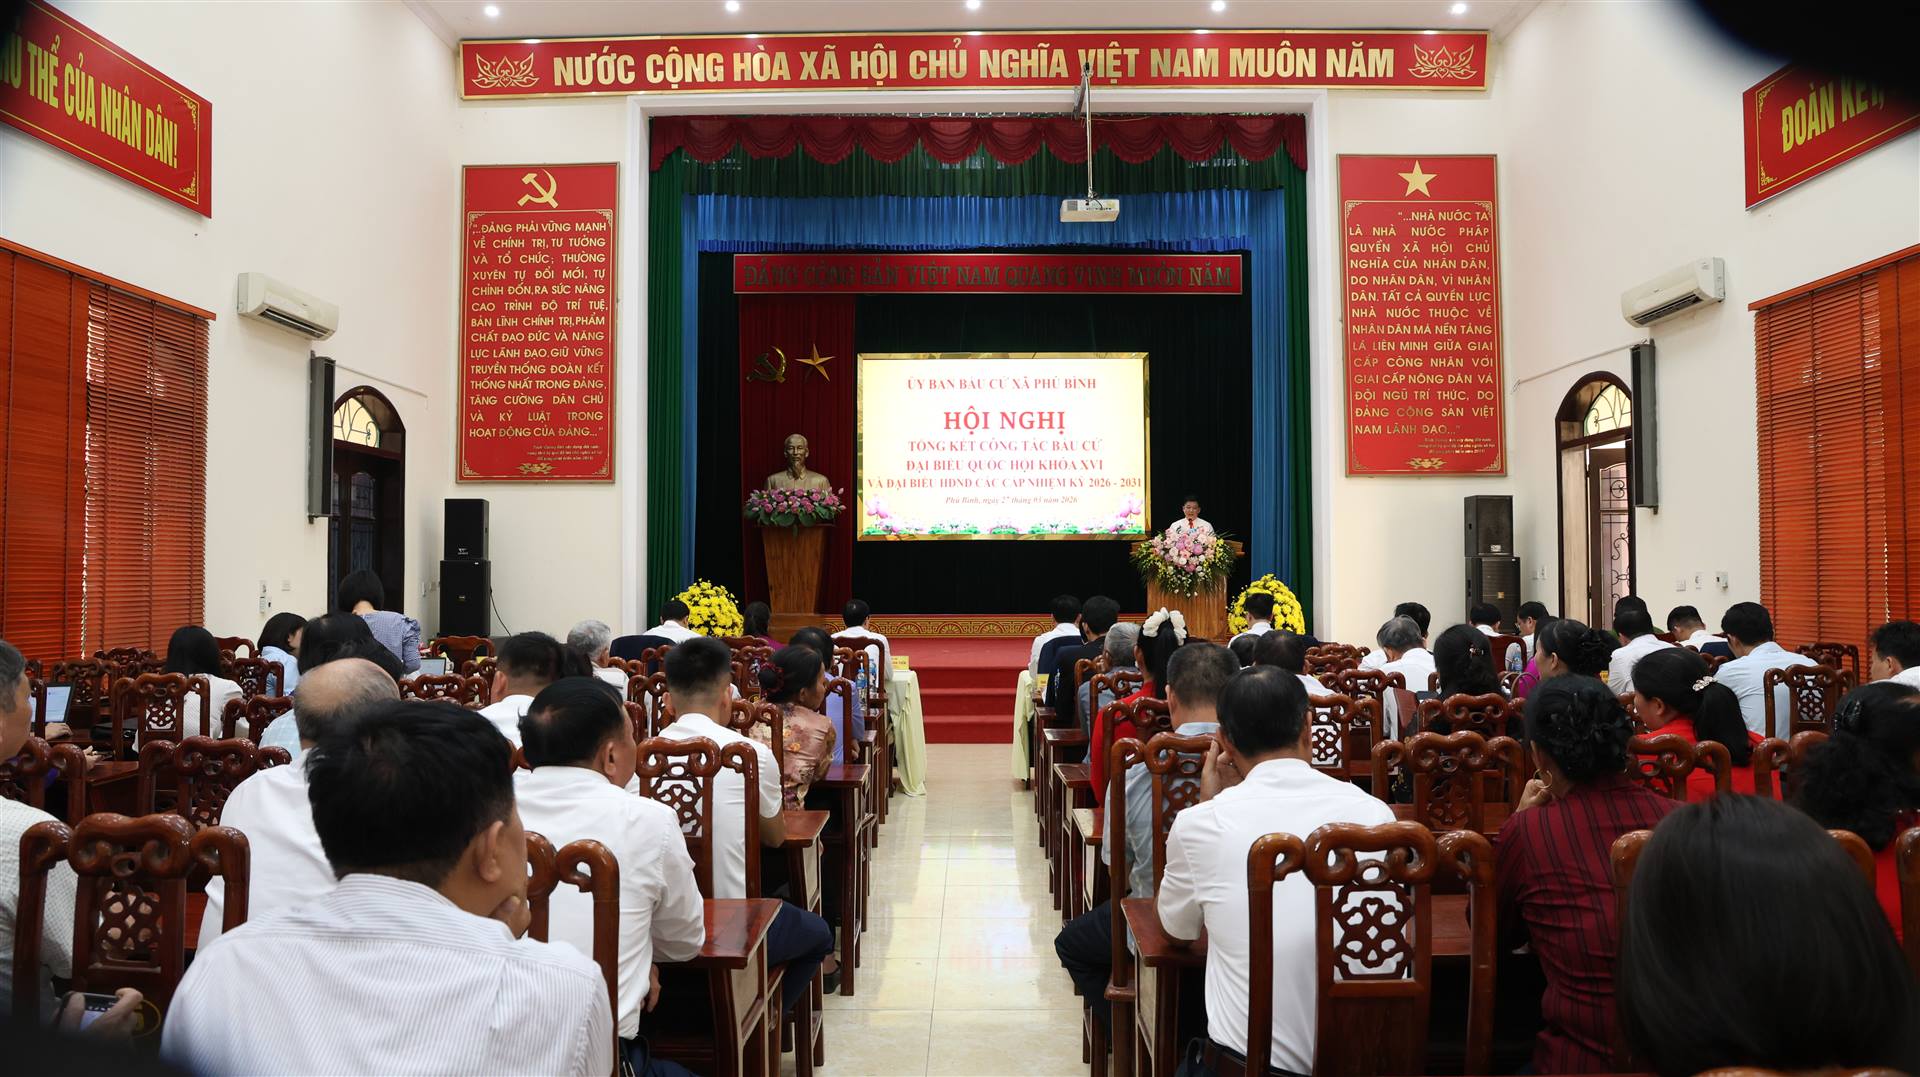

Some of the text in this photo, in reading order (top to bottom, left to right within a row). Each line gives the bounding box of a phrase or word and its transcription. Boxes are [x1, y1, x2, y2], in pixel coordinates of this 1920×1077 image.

[552, 37, 1395, 89] NƯỚC CỘNG HÒA XÃ HỘI CHỦ NGHĨA VIỆT NAM MUÔN NĂM
[27, 34, 177, 169] THỂ CỦA NHÂN DÂN!
[1781, 81, 1835, 154] ĐOÀN
[929, 379, 955, 390] BAN
[943, 405, 1066, 435] HỘI NGHỊ
[906, 460, 929, 474] ĐẠI
[1080, 460, 1103, 470] XVI
[1088, 478, 1111, 487] 2026
[1120, 478, 1142, 487] 2031
